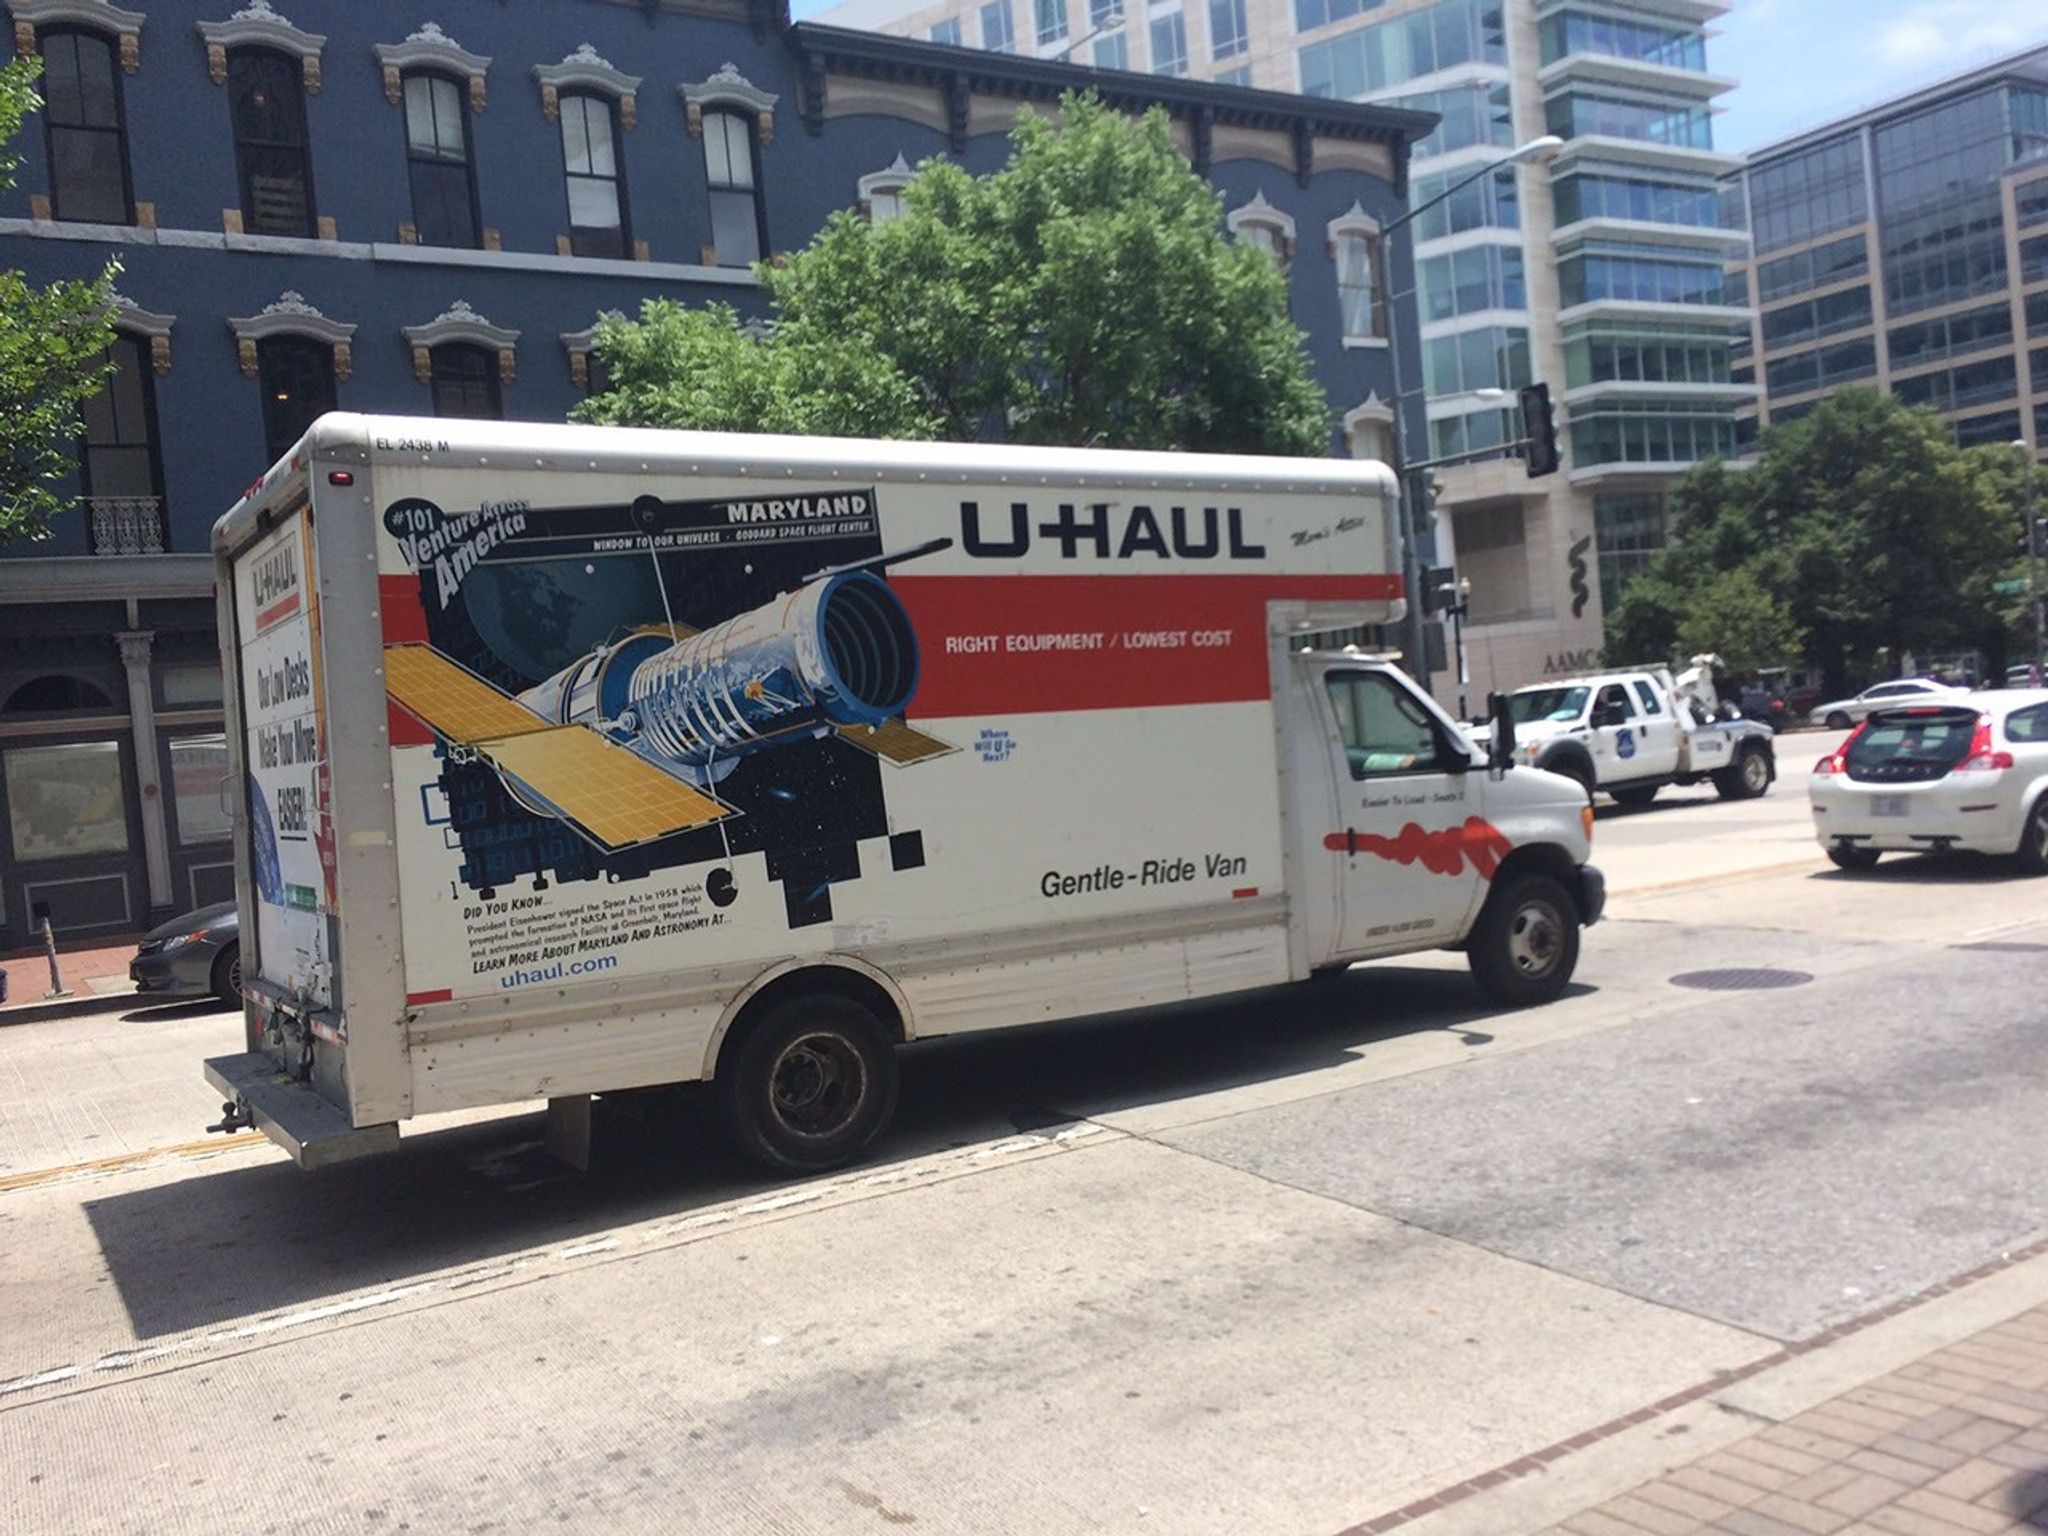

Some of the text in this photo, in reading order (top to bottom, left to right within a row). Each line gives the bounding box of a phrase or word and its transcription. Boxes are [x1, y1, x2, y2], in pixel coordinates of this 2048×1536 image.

[377, 438, 449, 451] EL 2438 M
[392, 508, 435, 531] #101
[727, 496, 867, 523] MARYLAND
[398, 511, 480, 568] Venture
[593, 521, 869, 551] WINDOW TO OUR UNIVERSE GODDARD SPACE FLIGHT CENTER
[960, 501, 1266, 559] U-HAUL
[434, 514, 527, 610] America
[946, 635, 998, 653] RIGHT
[1006, 633, 1104, 652] EQUIPMENT
[1123, 631, 1186, 649] LOWEST
[1191, 630, 1233, 647] COST
[1041, 853, 1247, 897] Gentle-Ride Van
[464, 907, 482, 919] DID
[486, 902, 508, 916] YOU
[467, 920, 507, 934] President
[510, 912, 556, 927] Eisenhower
[559, 905, 584, 917] signed
[587, 903, 599, 912] the
[602, 899, 625, 910] Space
[628, 894, 643, 904] Act
[655, 888, 678, 899] 1958
[681, 883, 702, 894] which
[469, 932, 508, 947] prompted
[527, 922, 567, 935] formation
[580, 912, 607, 925] NASA
[611, 909, 624, 919] and
[640, 903, 656, 914] first
[658, 900, 678, 912] space
[681, 895, 702, 905] flight
[471, 948, 486, 958] and
[489, 937, 541, 954] astronomical
[544, 930, 578, 944] research
[580, 925, 608, 936] facility
[473, 957, 506, 974] LEARN
[508, 951, 538, 966] MORE
[541, 943, 576, 960] ABOUT
[578, 933, 628, 952] MARYLAND
[631, 929, 651, 942] AND
[653, 918, 709, 938] ASTRONOMY
[501, 955, 617, 988] uhaul.com
